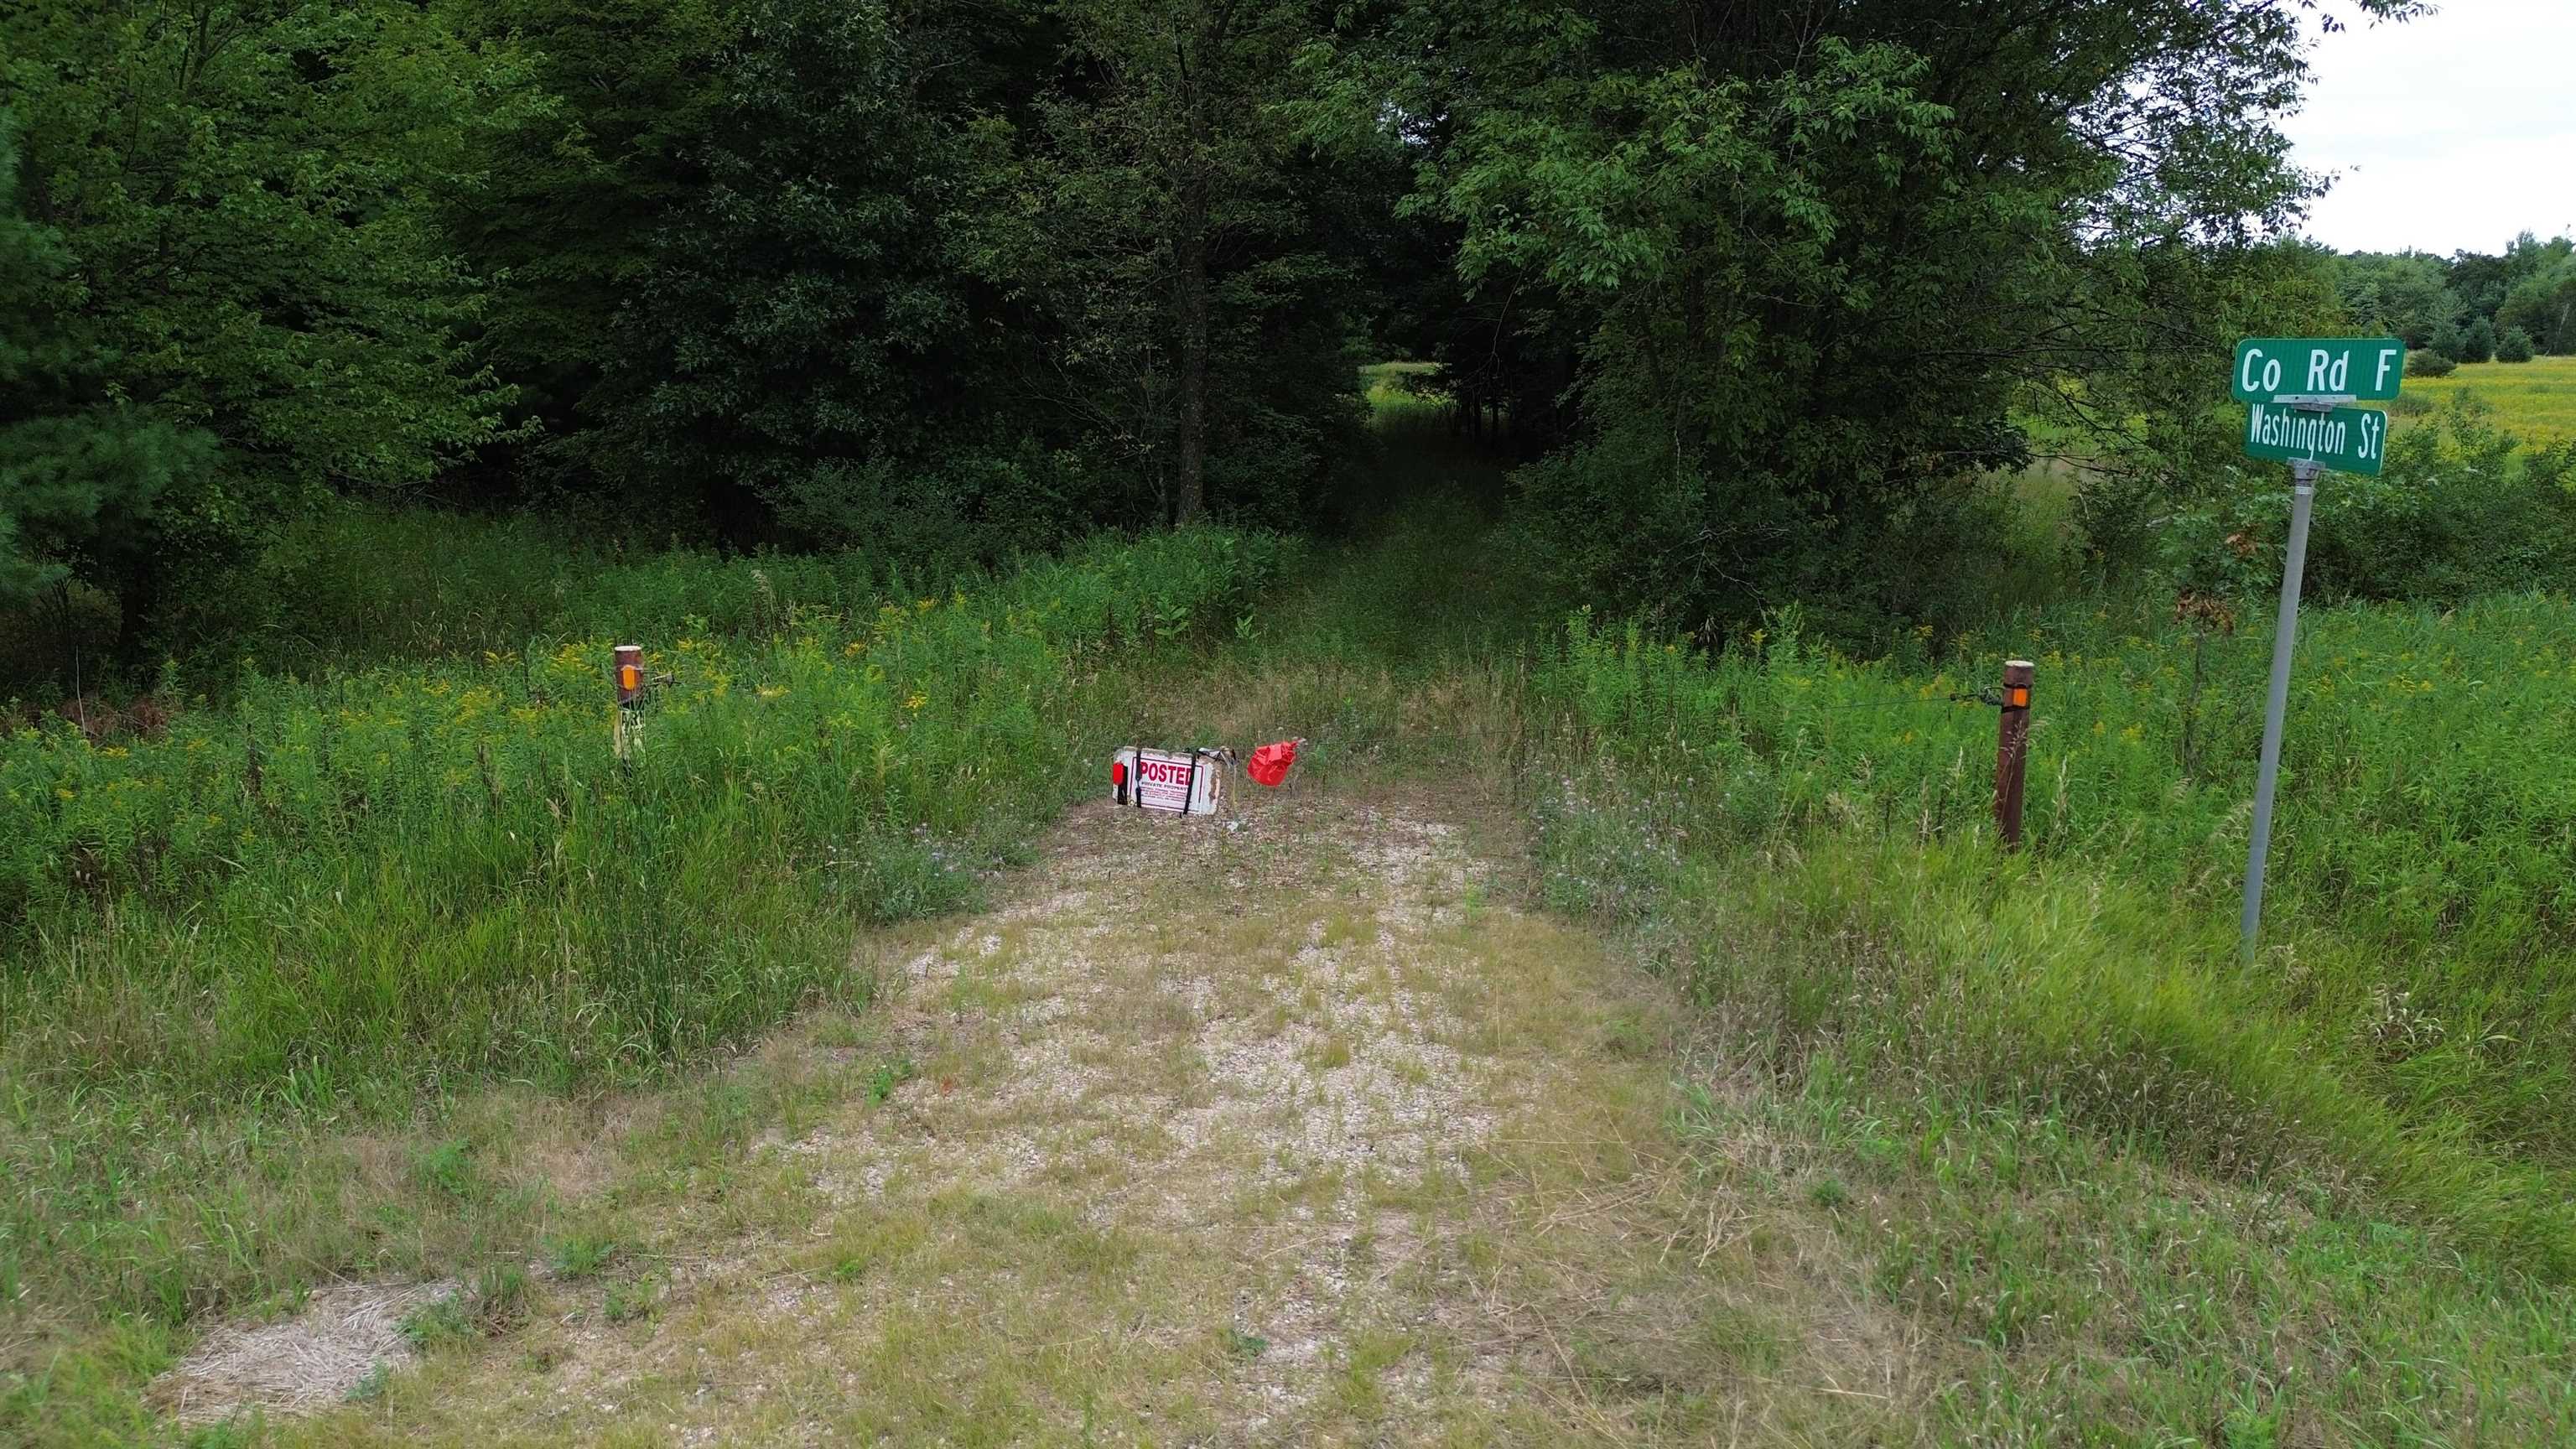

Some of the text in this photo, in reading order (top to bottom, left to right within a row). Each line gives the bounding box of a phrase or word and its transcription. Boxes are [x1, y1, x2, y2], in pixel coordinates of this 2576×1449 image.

[2241, 348, 2397, 392] Co Rd F
[2251, 403, 2380, 461] Washington St
